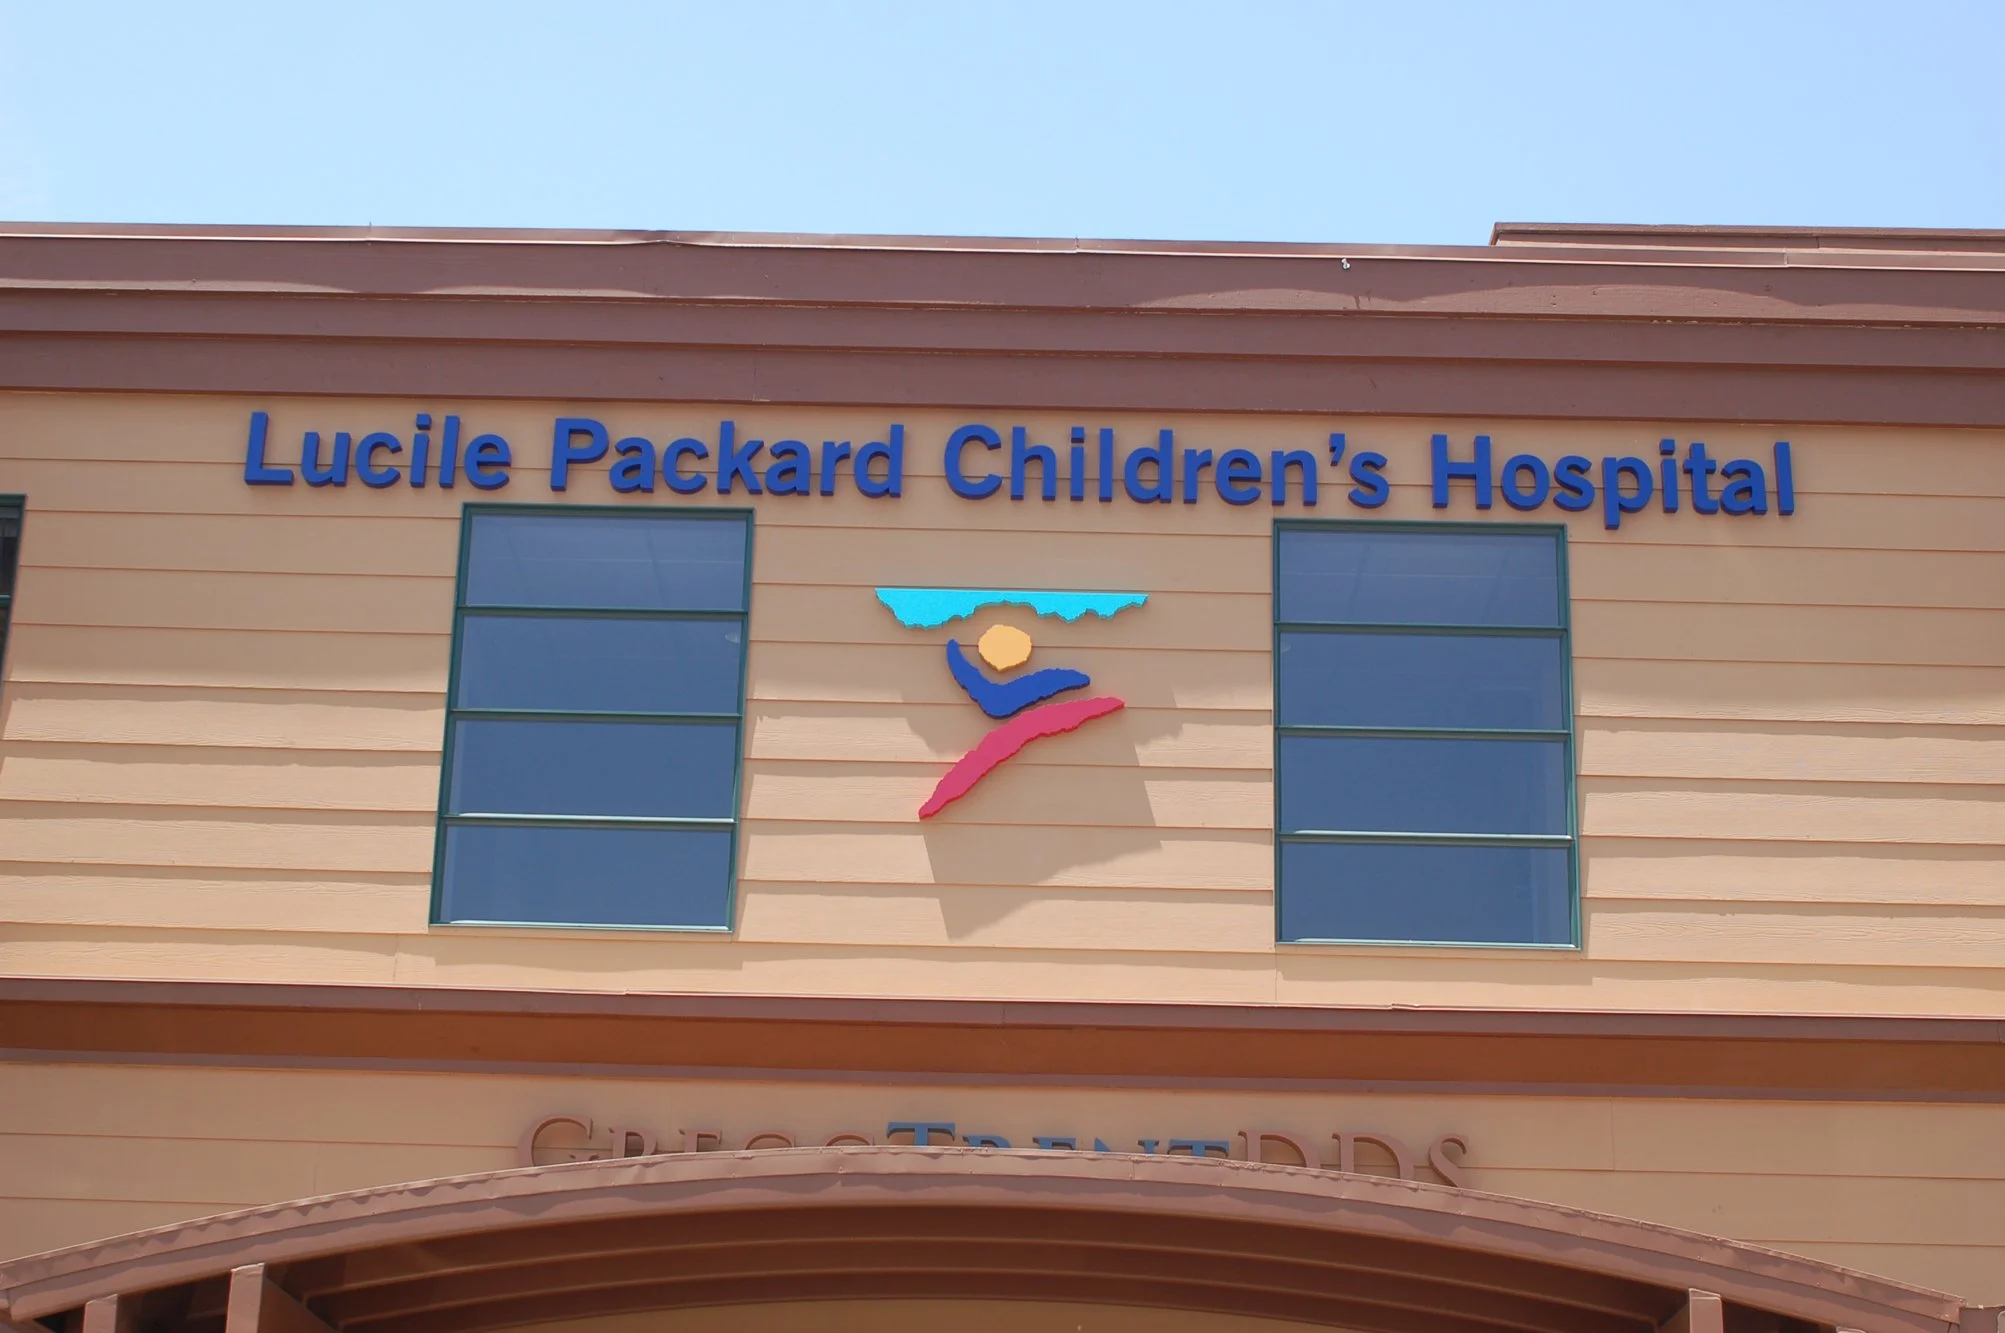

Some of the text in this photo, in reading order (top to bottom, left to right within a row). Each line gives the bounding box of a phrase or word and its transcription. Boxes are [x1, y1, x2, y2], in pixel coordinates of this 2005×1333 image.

[244, 411, 1796, 530] Lucile Packard Children's Hospital
